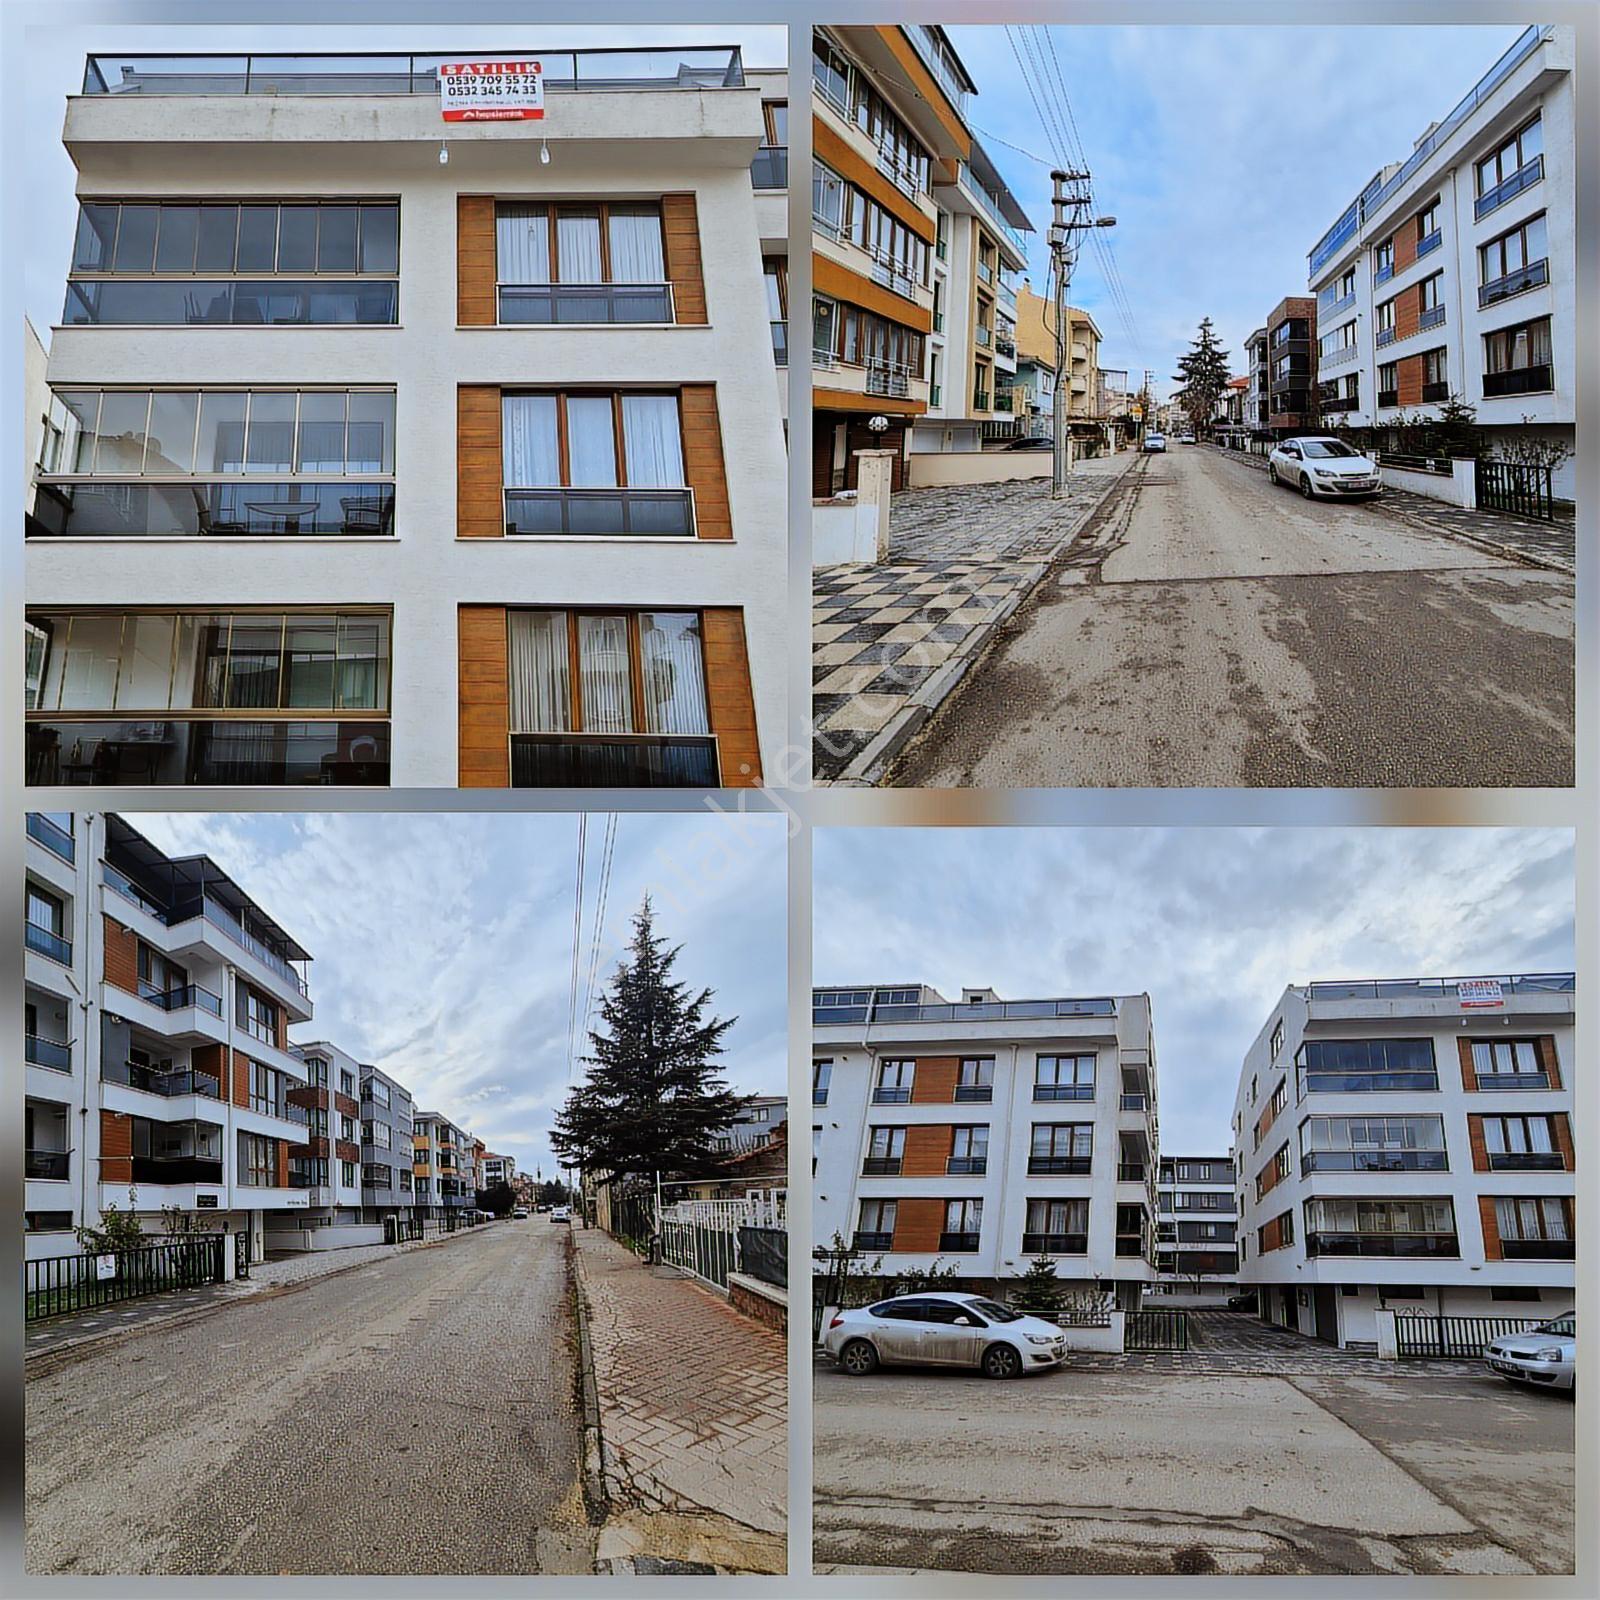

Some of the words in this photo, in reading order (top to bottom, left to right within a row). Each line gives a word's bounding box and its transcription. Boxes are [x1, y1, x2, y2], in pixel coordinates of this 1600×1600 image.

[446, 63, 537, 74] SATILIK
[447, 75, 477, 85] 0539
[479, 75, 502, 85] 709
[505, 75, 520, 85] 55
[522, 75, 537, 84] 72
[448, 86, 478, 96] 0532
[481, 86, 503, 96] 345
[505, 86, 519, 95] 74
[522, 85, 537, 95] 33
